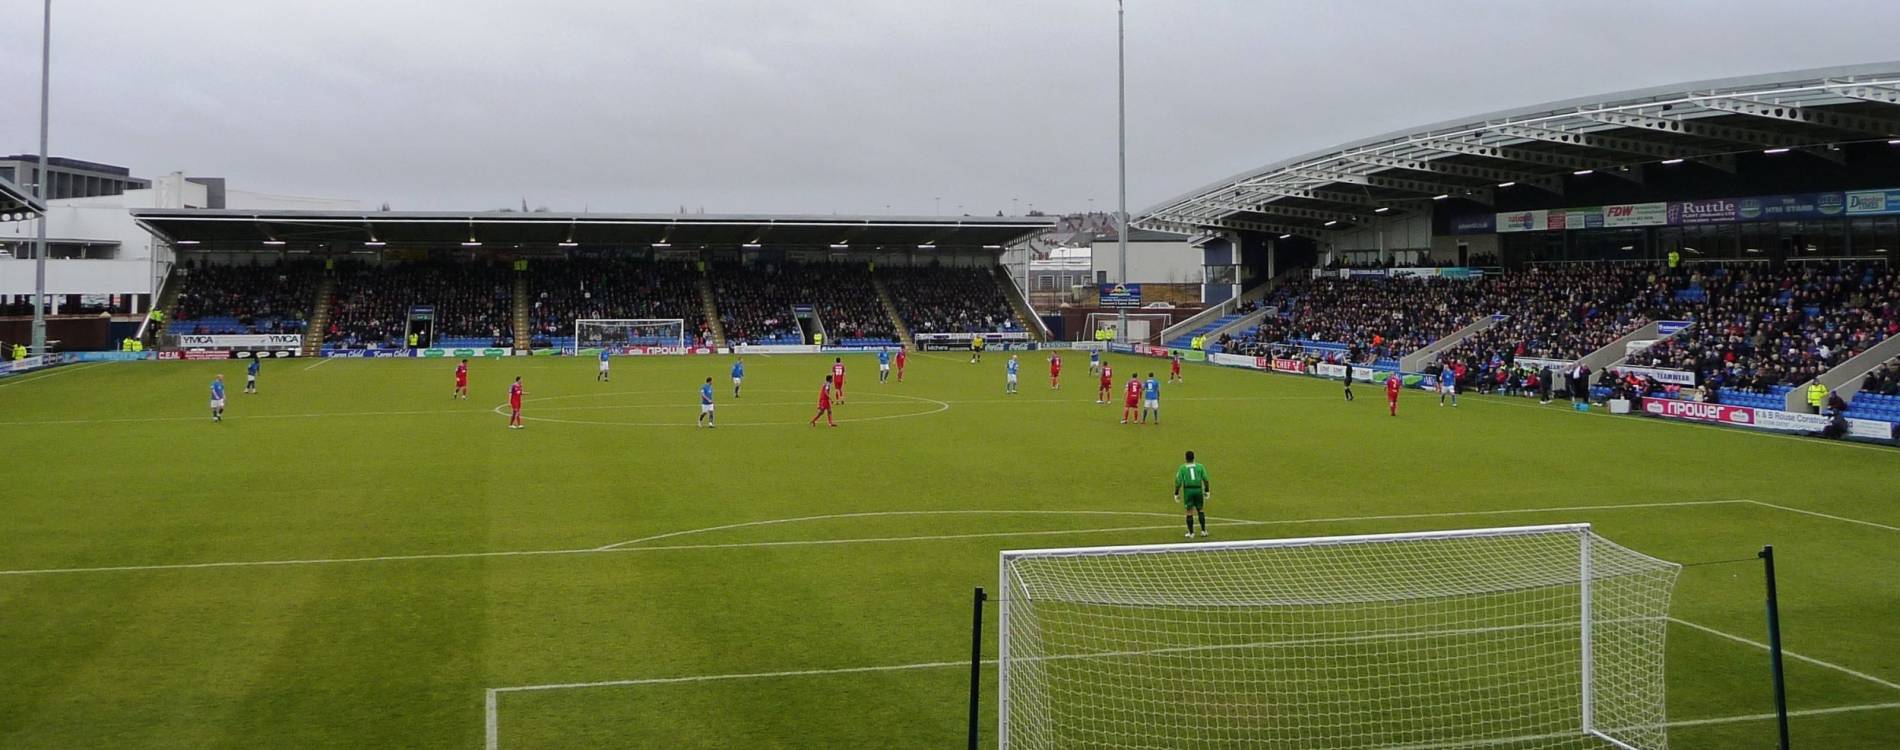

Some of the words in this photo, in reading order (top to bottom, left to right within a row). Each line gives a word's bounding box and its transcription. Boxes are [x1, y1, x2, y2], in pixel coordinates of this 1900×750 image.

[1607, 206, 1633, 217] FDW
[1682, 200, 1735, 214] Ruttle
[183, 336, 213, 344] YMCA
[269, 335, 298, 343] YMCA
[1657, 373, 1690, 382] TEAMWEAR
[1668, 401, 1725, 419] npower
[1190, 467, 1195, 480] 1
